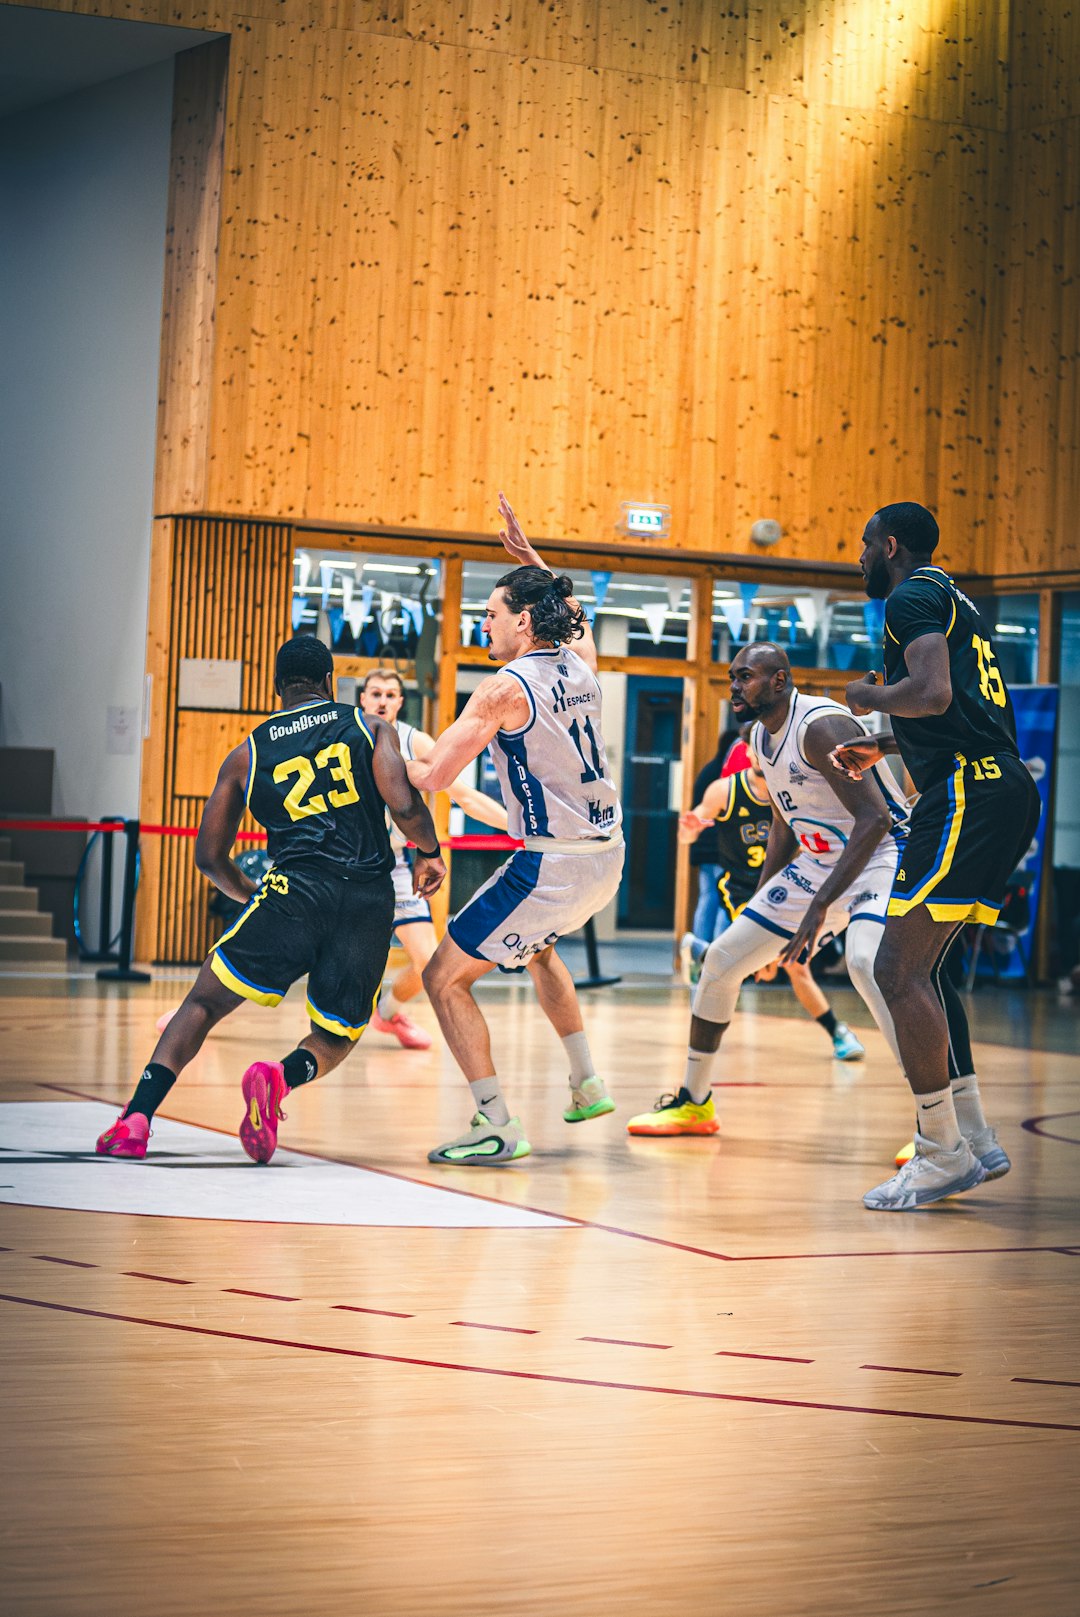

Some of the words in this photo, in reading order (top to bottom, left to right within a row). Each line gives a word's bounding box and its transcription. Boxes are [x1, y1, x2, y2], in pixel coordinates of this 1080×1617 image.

[971, 633, 1007, 708] 15
[566, 692, 591, 707] ESPACE
[568, 715, 605, 784] 11
[971, 755, 1002, 780] 15
[272, 742, 360, 822] 23
[777, 790, 798, 812] 12
[747, 845, 767, 868] 3
